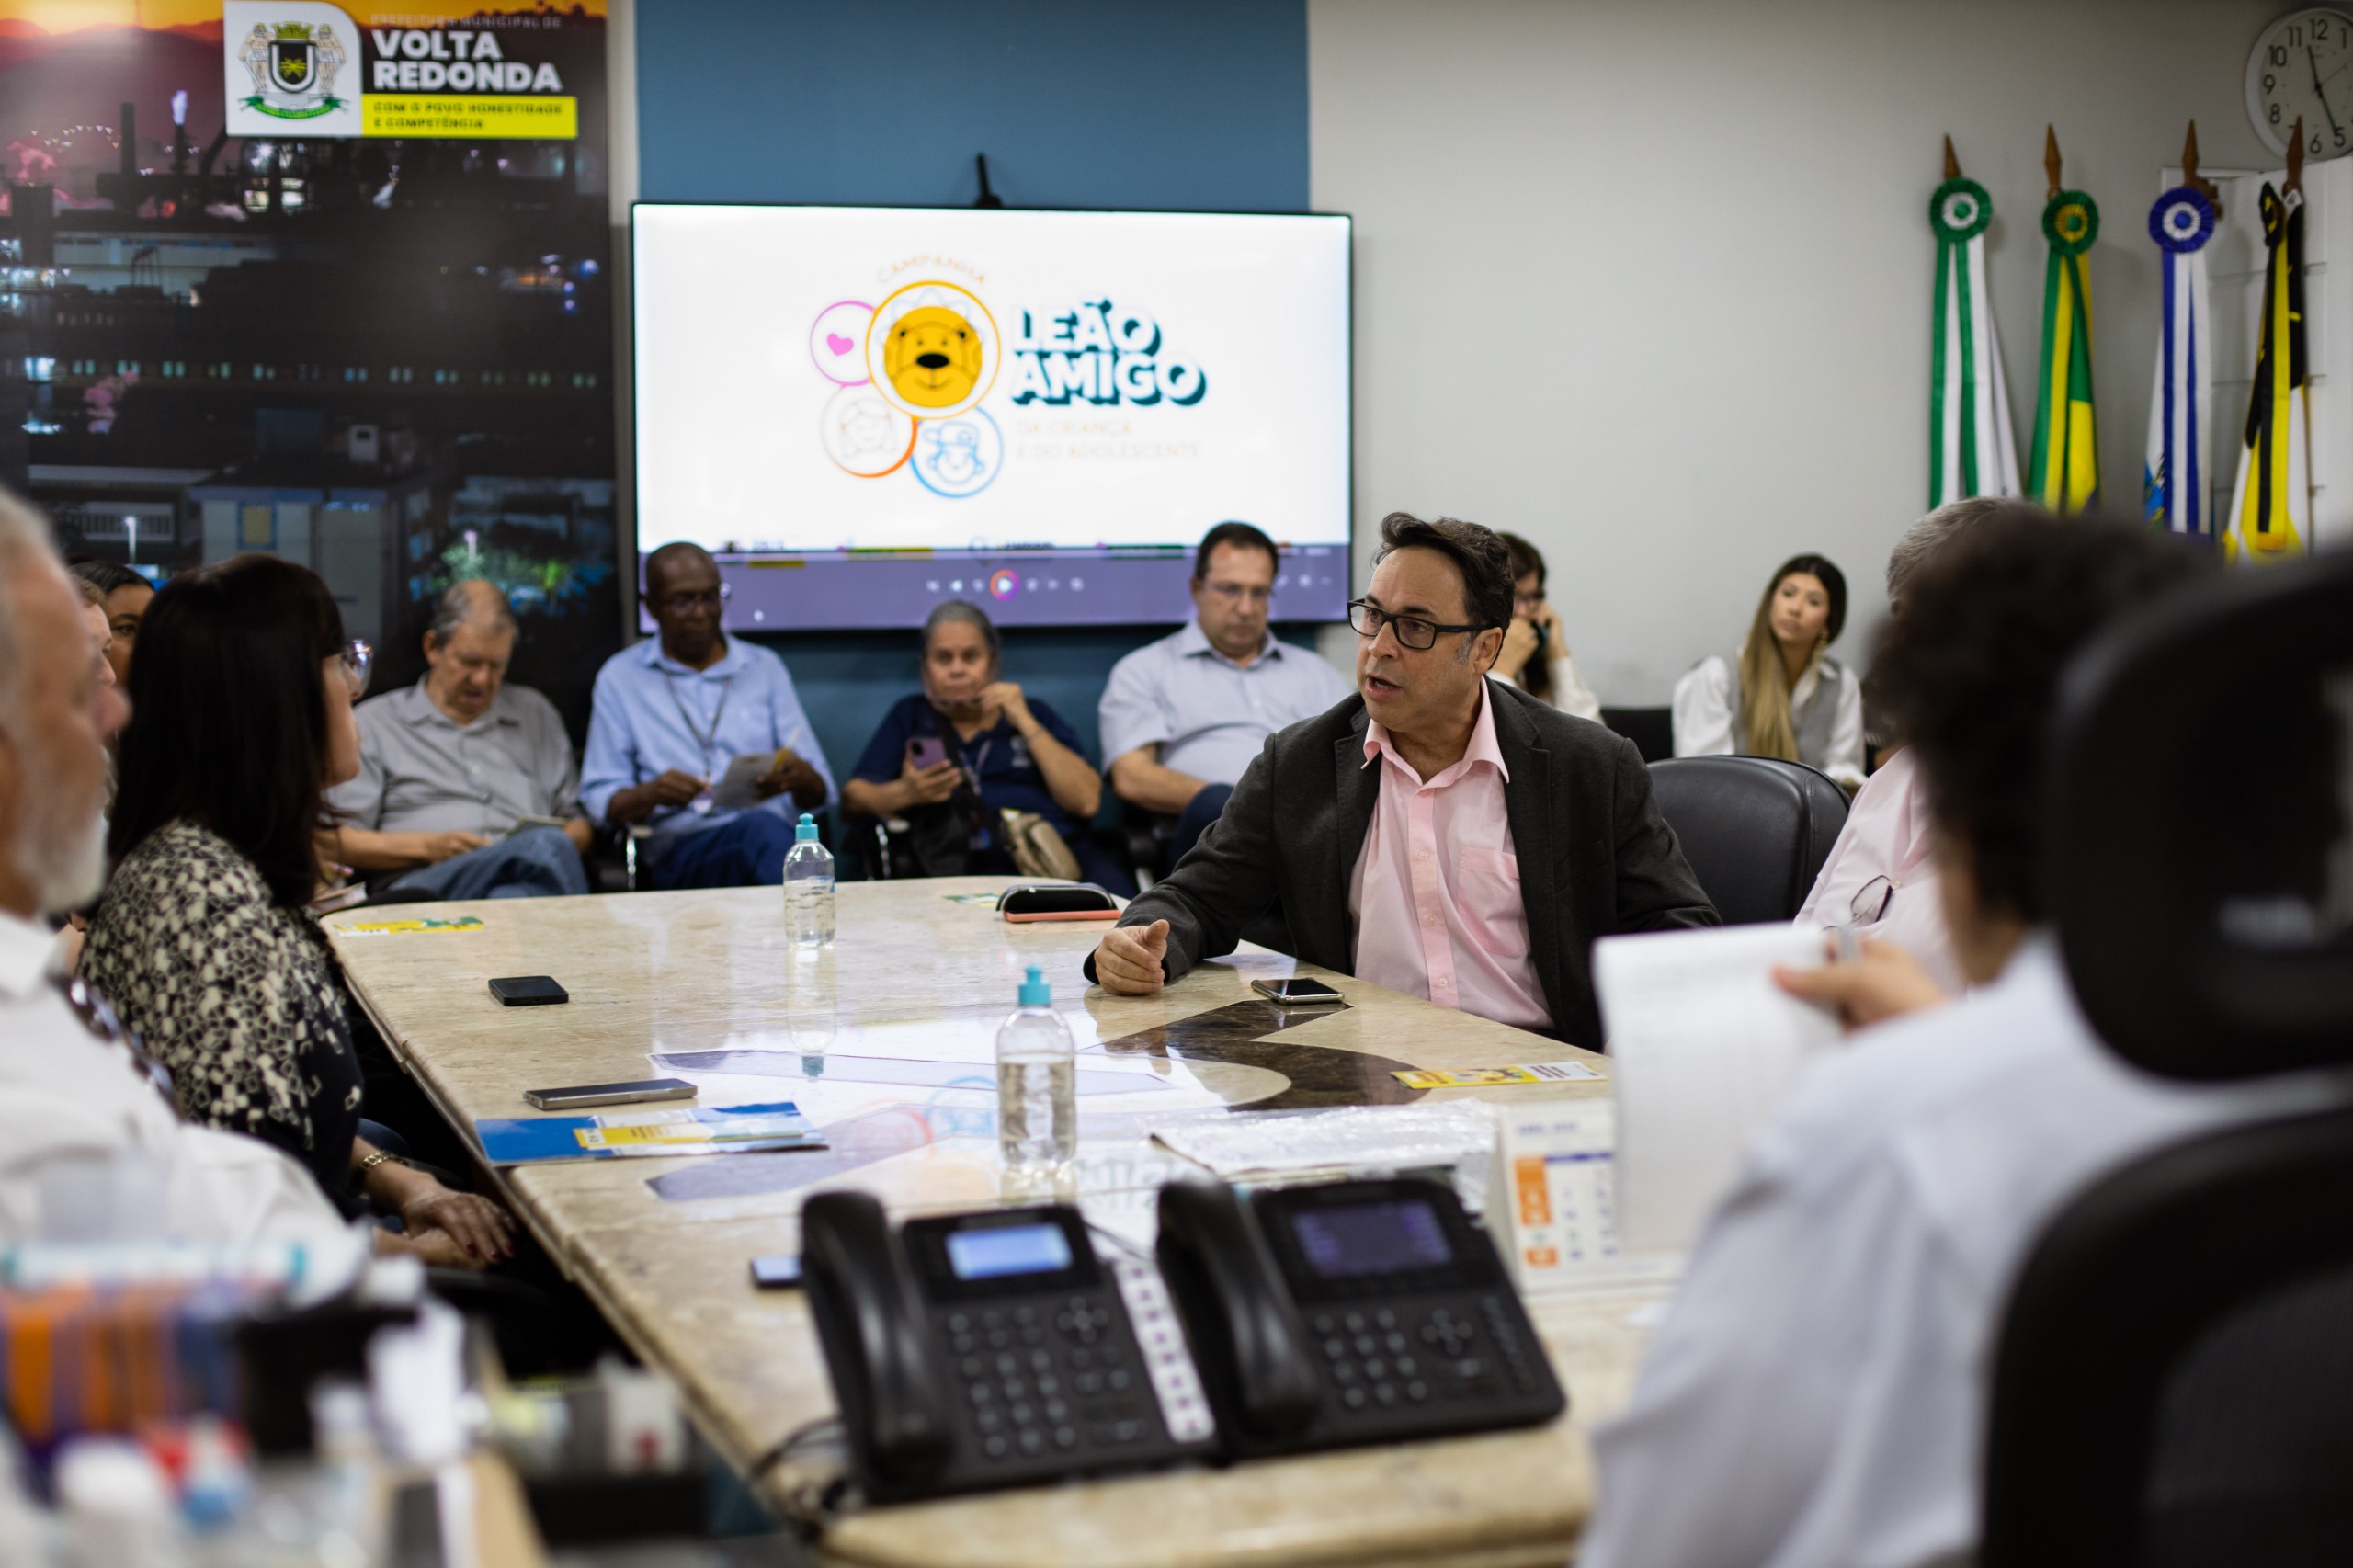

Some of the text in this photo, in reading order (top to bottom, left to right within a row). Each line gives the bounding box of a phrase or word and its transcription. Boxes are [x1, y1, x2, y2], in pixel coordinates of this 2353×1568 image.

[370, 14, 563, 30] PREFEITURA MUNICIPAL DE
[2308, 18, 2329, 40] 12
[371, 29, 503, 61] VOLTA
[2287, 26, 2303, 49] 11
[2340, 28, 2347, 50] 1
[2268, 45, 2288, 67] 10
[373, 61, 563, 92] REDONDA
[2263, 74, 2276, 96] 9
[373, 101, 406, 113] COM
[425, 102, 463, 113] POVO
[467, 102, 563, 115] HONESTIDADE
[2269, 103, 2282, 125] 8
[373, 116, 484, 129] E COMPETÊNCIA
[2309, 133, 2323, 154] 6
[2333, 126, 2347, 148] 5
[877, 253, 988, 285] CAMPANHA
[1010, 296, 1162, 357] LEÃO
[1009, 347, 1207, 405] AMIGO
[1017, 418, 1132, 437] DA CRIANÇA
[1032, 442, 1061, 458] DO
[1067, 441, 1201, 458] ADOLESCENTE
